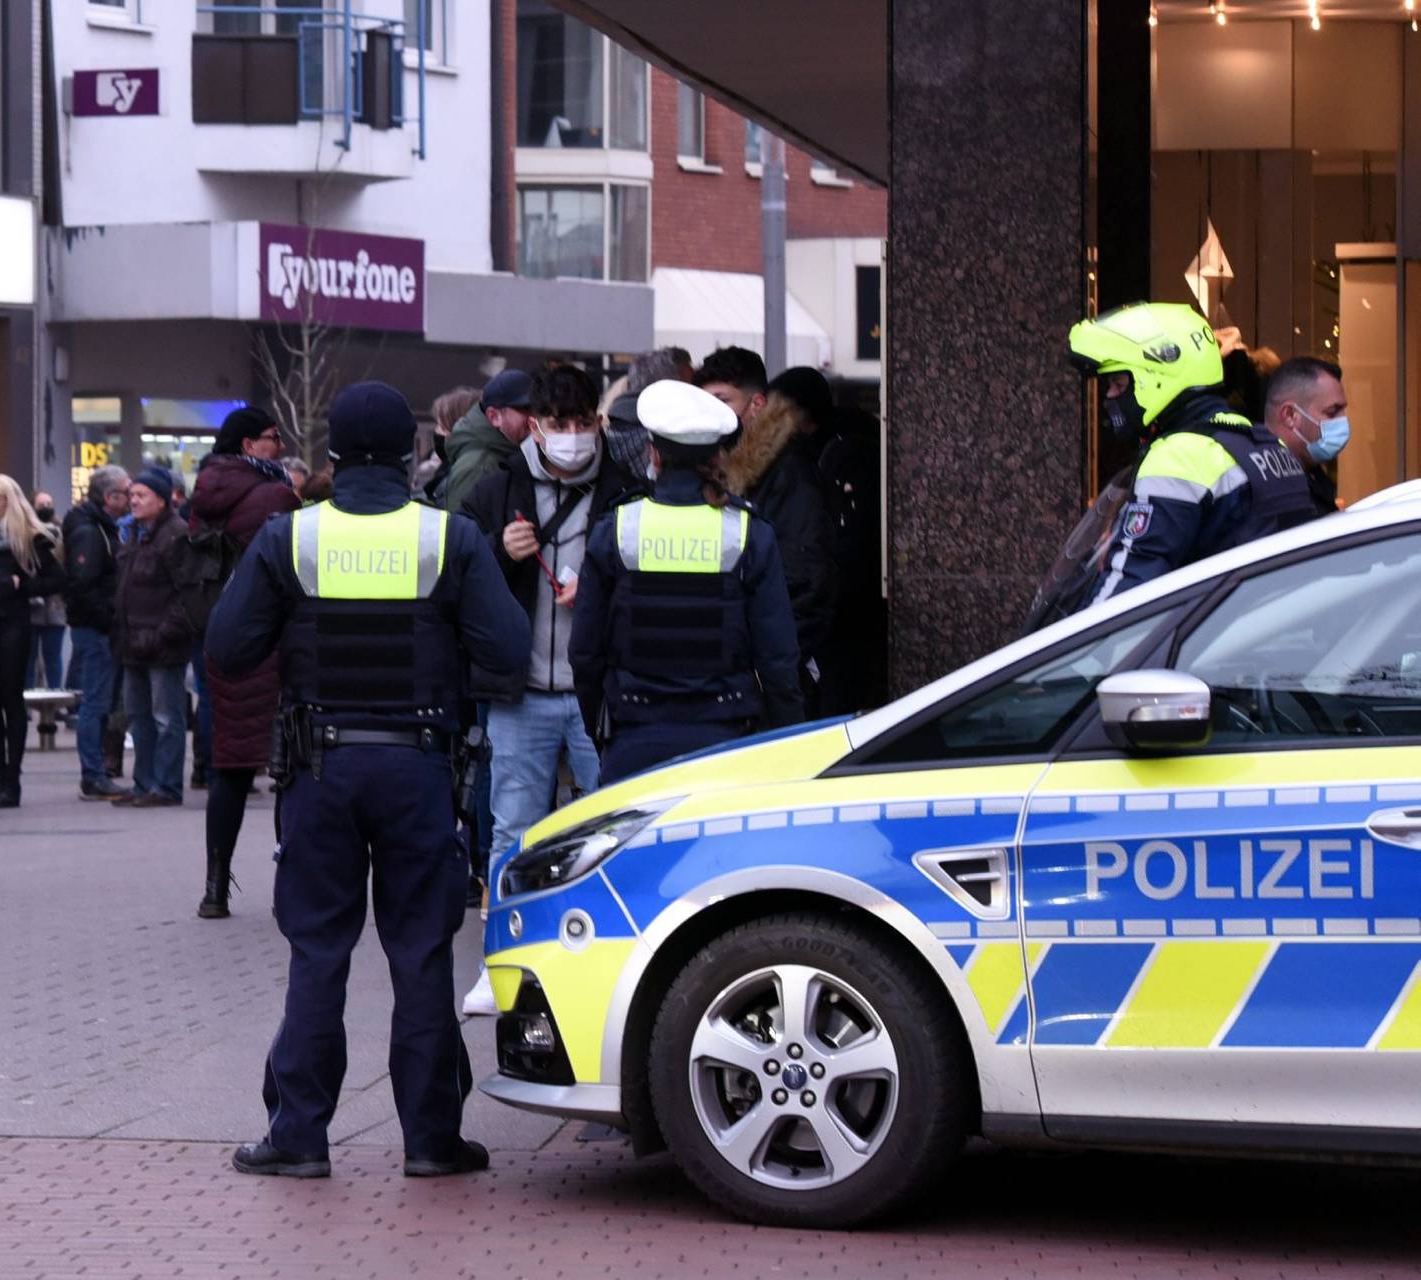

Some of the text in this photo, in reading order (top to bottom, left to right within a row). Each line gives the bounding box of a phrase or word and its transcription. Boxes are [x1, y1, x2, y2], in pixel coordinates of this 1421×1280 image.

[115, 78, 142, 113] y
[282, 248, 416, 309] yourfone
[326, 549, 407, 575] POLIZEI
[641, 538, 718, 561] POLIZEI
[1084, 839, 1375, 901] POLIZEI
